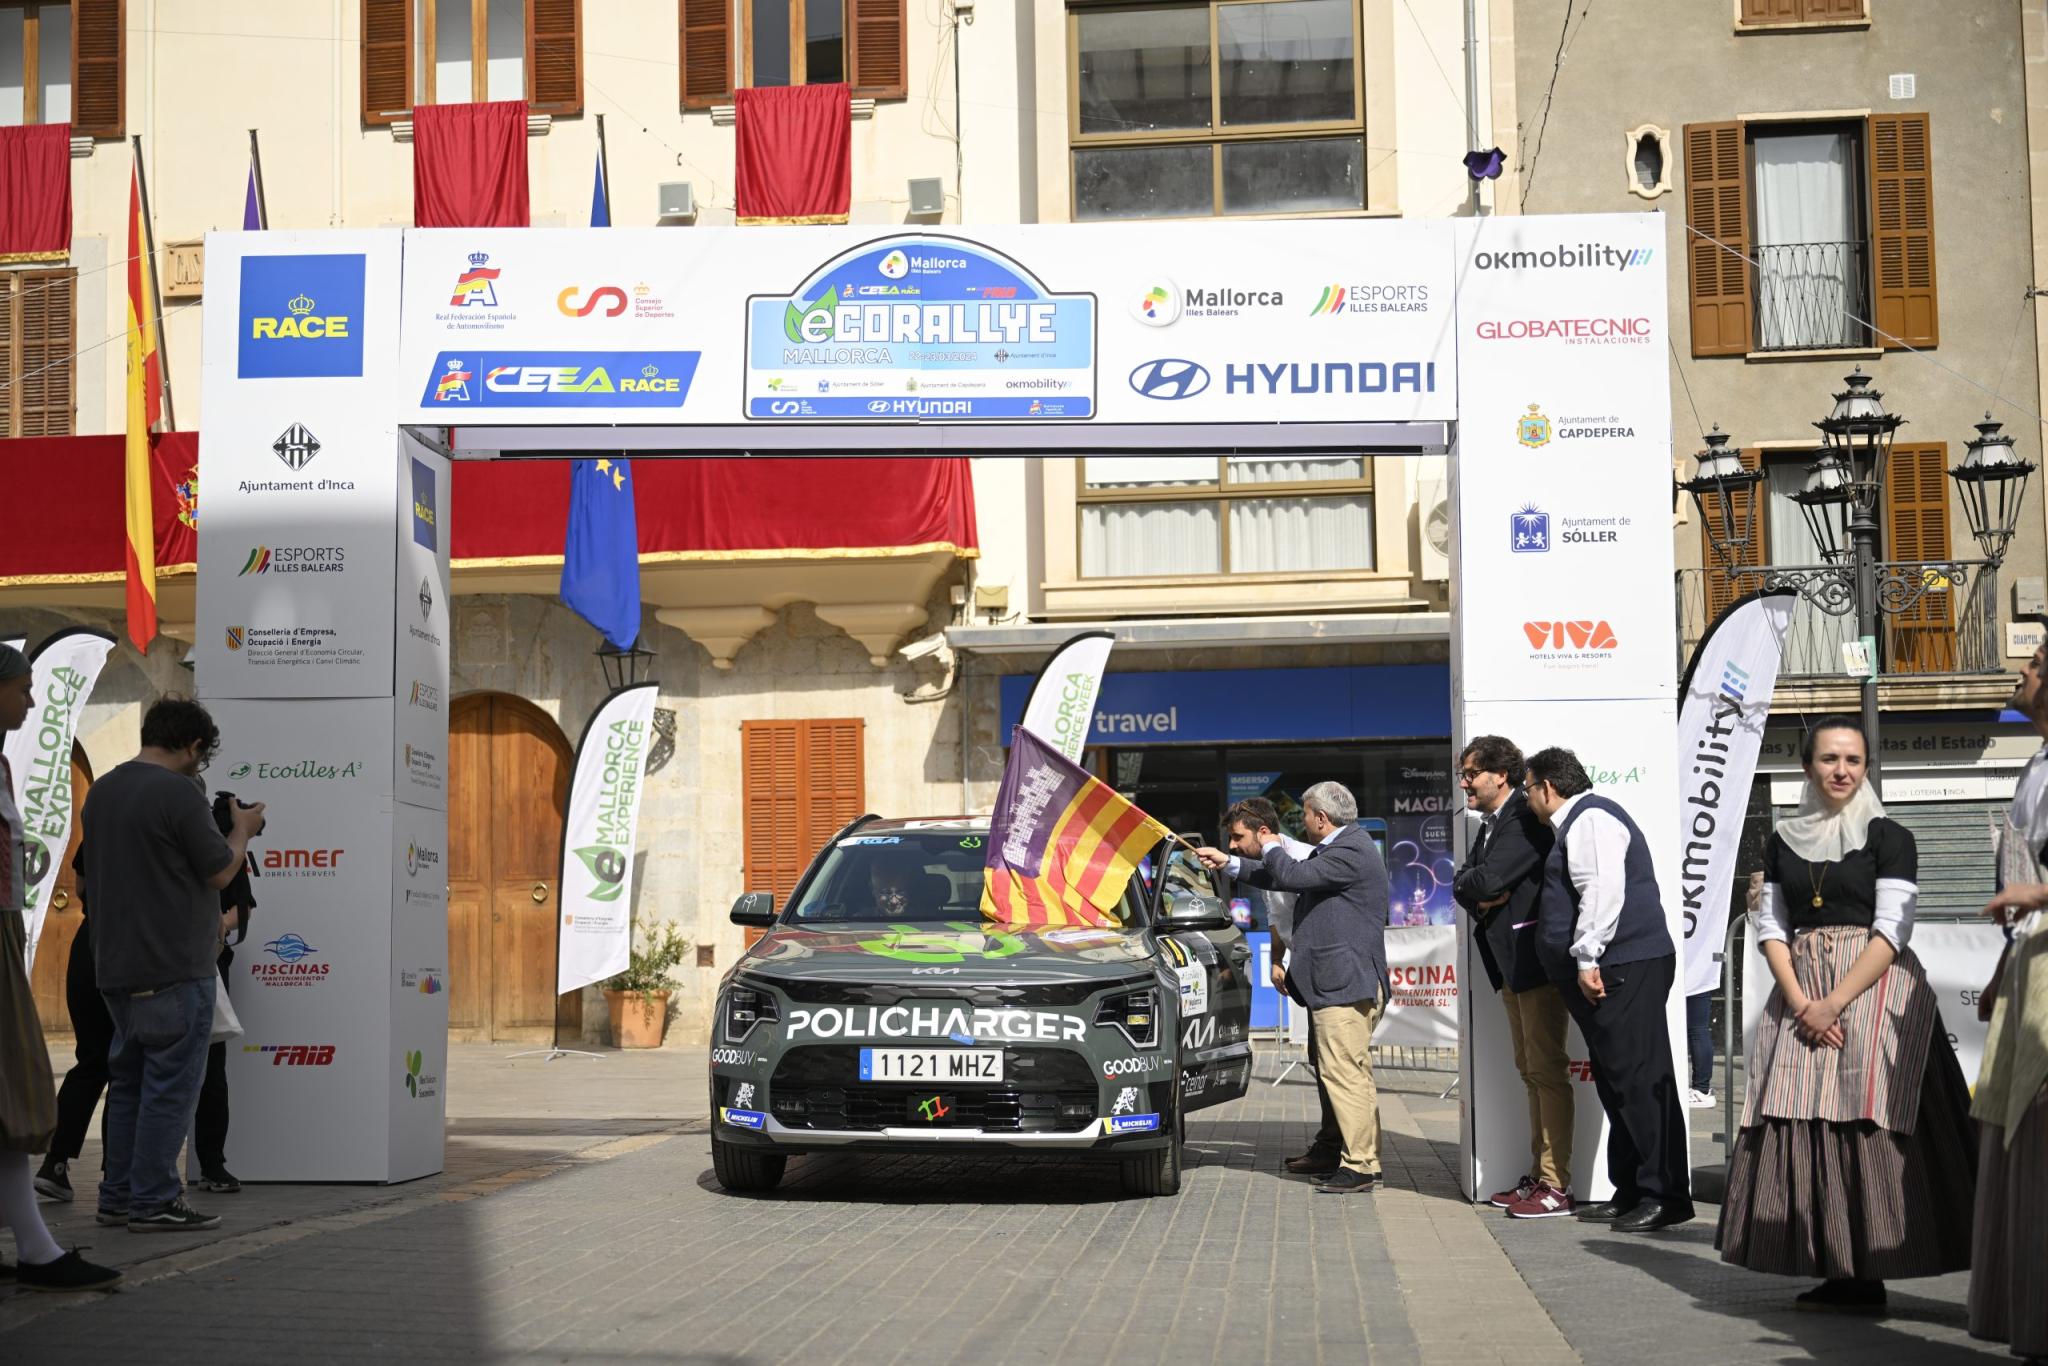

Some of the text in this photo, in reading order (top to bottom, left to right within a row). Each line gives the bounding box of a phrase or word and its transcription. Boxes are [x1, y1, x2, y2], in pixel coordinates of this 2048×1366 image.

[911, 256, 966, 269] Mallorca
[1474, 242, 1632, 272] okmobility
[1186, 287, 1284, 307] Mallorca
[1350, 284, 1428, 300] ESPORTS
[1186, 308, 1239, 317] Illes Balears
[1350, 302, 1428, 312] ILLES BALEARS
[488, 313, 516, 322] Española
[252, 316, 348, 340] RACE
[1476, 318, 1651, 340] GLOBATECNIC
[1565, 336, 1651, 345] INSTALACIONES
[783, 348, 893, 364] MALLORCA
[486, 366, 680, 393] CEEA RACE
[1006, 378, 1065, 390] okmobility
[1226, 361, 1435, 394] HYUNDAI
[893, 401, 972, 414] HYUNDAI
[1558, 415, 1620, 426] Ajuntament de
[1558, 427, 1635, 439] CAPDEPERA
[238, 479, 355, 494] Ajuntament d'Inca
[415, 502, 434, 526] RACE
[1562, 516, 1631, 527] Ajuntament de
[1562, 528, 1617, 543] SÓLLER
[274, 547, 345, 562] ESPORTS
[274, 563, 344, 572] ILLES BALEARS
[248, 628, 291, 636] Conselleria
[1523, 620, 1618, 650] VIVA
[248, 638, 284, 647] Ocupació
[292, 638, 322, 647] Energia
[1096, 706, 1176, 732] travel
[24, 666, 73, 832] MALLORCA
[1788, 744, 1795, 756] y
[1912, 736, 1936, 750] del
[1942, 735, 1996, 750] Estado
[258, 760, 336, 779] Ecoilles
[596, 719, 628, 846] MALLORCA
[615, 720, 644, 846] EXPERIENCE
[1394, 796, 1455, 812] MAGIA
[264, 850, 344, 868] amer
[417, 846, 439, 864] Mallorca
[252, 964, 330, 975] PISCINAS
[786, 1006, 1087, 1042] POLICHARGER
[1182, 1016, 1216, 1049] KIA
[273, 1046, 336, 1065] FAIB
[881, 1054, 996, 1077] 1121 MHZ
[731, 1114, 758, 1123] MICHELIN
